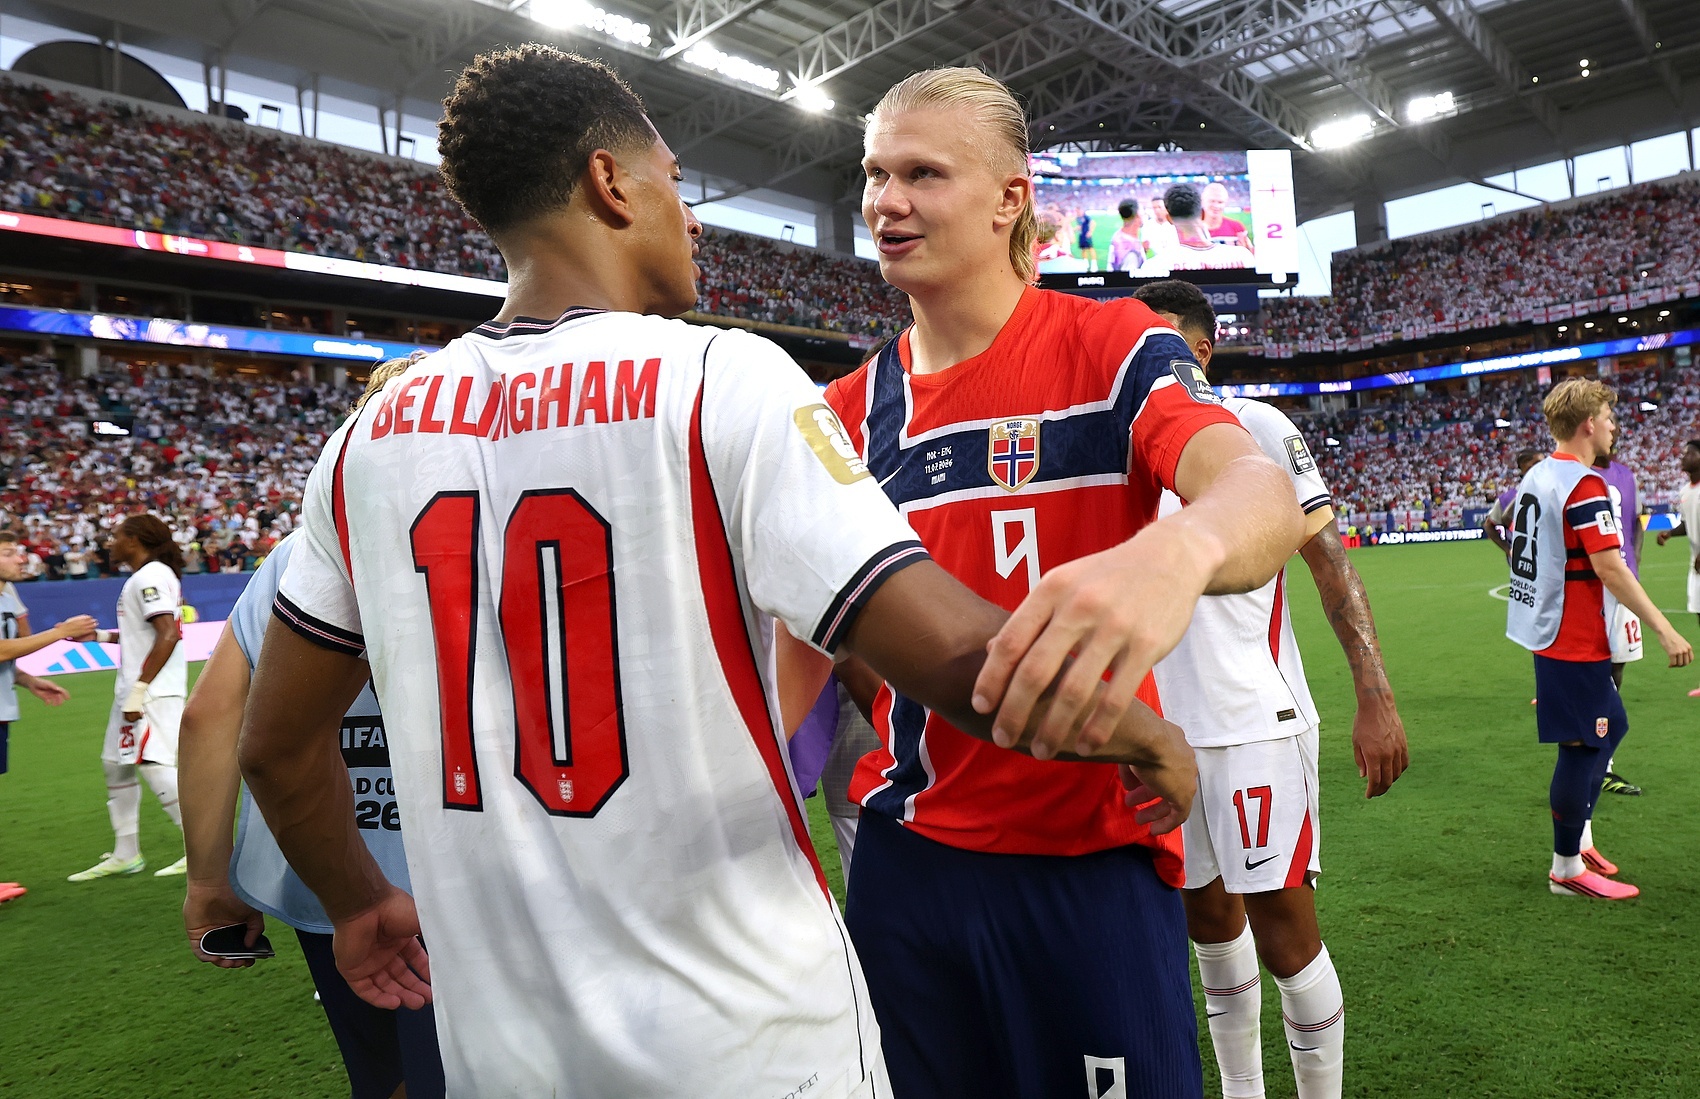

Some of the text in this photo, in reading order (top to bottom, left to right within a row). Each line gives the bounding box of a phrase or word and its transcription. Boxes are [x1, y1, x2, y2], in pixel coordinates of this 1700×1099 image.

[1267, 223, 1283, 238] 2
[1006, 421, 1023, 430] NORGE
[990, 507, 1041, 595] 9
[1378, 532, 1405, 545] ADI
[1509, 586, 1535, 608] 2026
[1624, 619, 1641, 644] 12
[409, 486, 630, 819] 10
[119, 724, 135, 749] 25
[338, 726, 386, 749] IFA
[355, 799, 402, 831] 26
[1232, 784, 1273, 850] 17
